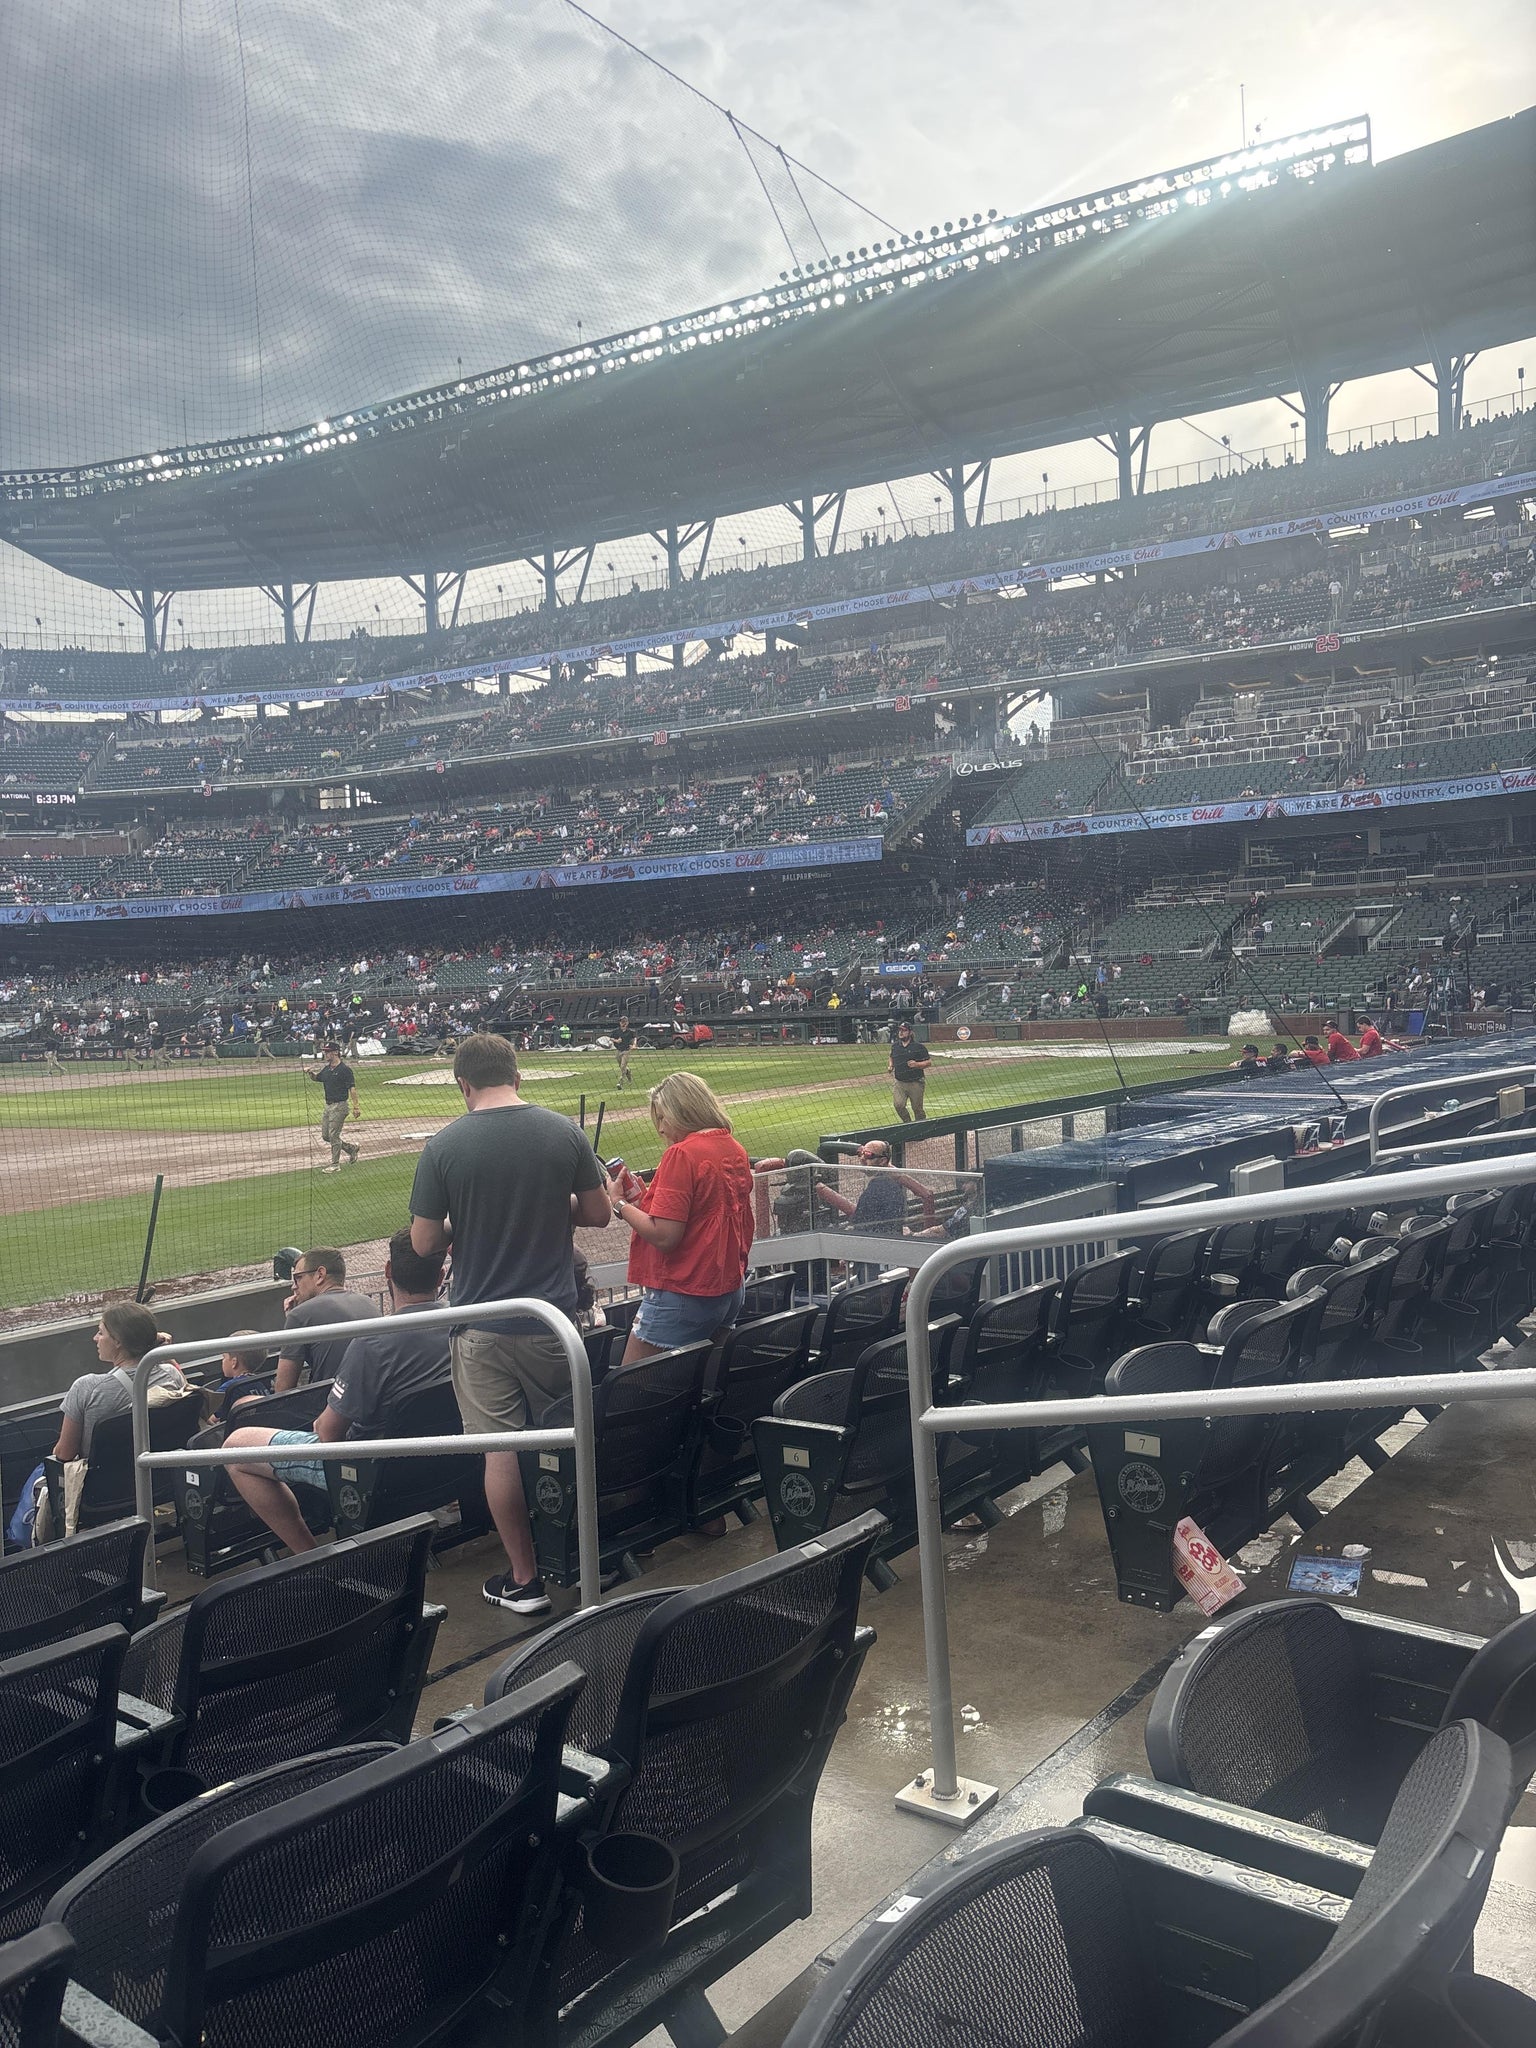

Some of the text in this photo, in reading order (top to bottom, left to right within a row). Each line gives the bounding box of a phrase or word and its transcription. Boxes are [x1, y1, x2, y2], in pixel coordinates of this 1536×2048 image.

[1249, 530, 1262, 539] WE
[1265, 527, 1283, 537] ARE
[1287, 518, 1323, 535] Braves
[1327, 510, 1377, 525] COUNTRY,
[1381, 500, 1423, 516] CHOOSE
[1427, 490, 1460, 507] Chill
[984, 578, 995, 586] WE
[999, 575, 1014, 584] ARE
[1016, 567, 1047, 581] Braves
[1094, 553, 1130, 567] CHOOSE
[1133, 546, 1162, 560] Chill
[771, 615, 785, 624] ARE
[787, 610, 813, 622] Braves
[853, 597, 884, 609] CHOOSE
[887, 591, 911, 605] Chill
[590, 644, 612, 656] Braves
[647, 635, 674, 646] CHOOSE
[675, 630, 696, 641] Chill
[1289, 633, 1360, 653] ANDRUW 25 JONES
[895, 695, 911, 712] 21
[653, 730, 667, 745] 10
[436, 759, 444, 773] 6
[973, 759, 1023, 772] LEXUS
[203, 784, 211, 796] 3
[1297, 802, 1313, 812] WE
[1316, 799, 1337, 810] ARE
[1341, 792, 1382, 809] Braves
[1386, 788, 1445, 801] COUNTRY,
[1448, 781, 1497, 795] CHOOSE
[1502, 771, 1536, 790] Chill
[36, 794, 76, 804] 6:33 PM
[1014, 807, 1225, 837] WE ARE Braves COUNTRY, CHOOSE Chill
[564, 872, 577, 881] WE
[579, 870, 597, 879] ARE
[600, 864, 635, 880] Braves
[638, 862, 686, 875] COUNTRY,
[690, 859, 731, 870] CHOOSE
[735, 853, 767, 868] Chill
[312, 892, 323, 902] WE
[325, 891, 340, 900] ARE
[343, 888, 371, 900] Braves
[416, 883, 450, 893] CHOOSE
[453, 878, 479, 891] Chill
[57, 899, 243, 918] WE ARE Braves COUNTRY, CHOOSE Chill
[886, 964, 916, 972] GEICO
[1465, 1023, 1509, 1032] TRUIST PAR
[1139, 1438, 1146, 1449] 7
[793, 1452, 800, 1462] 6
[890, 1905, 908, 1913] 2
